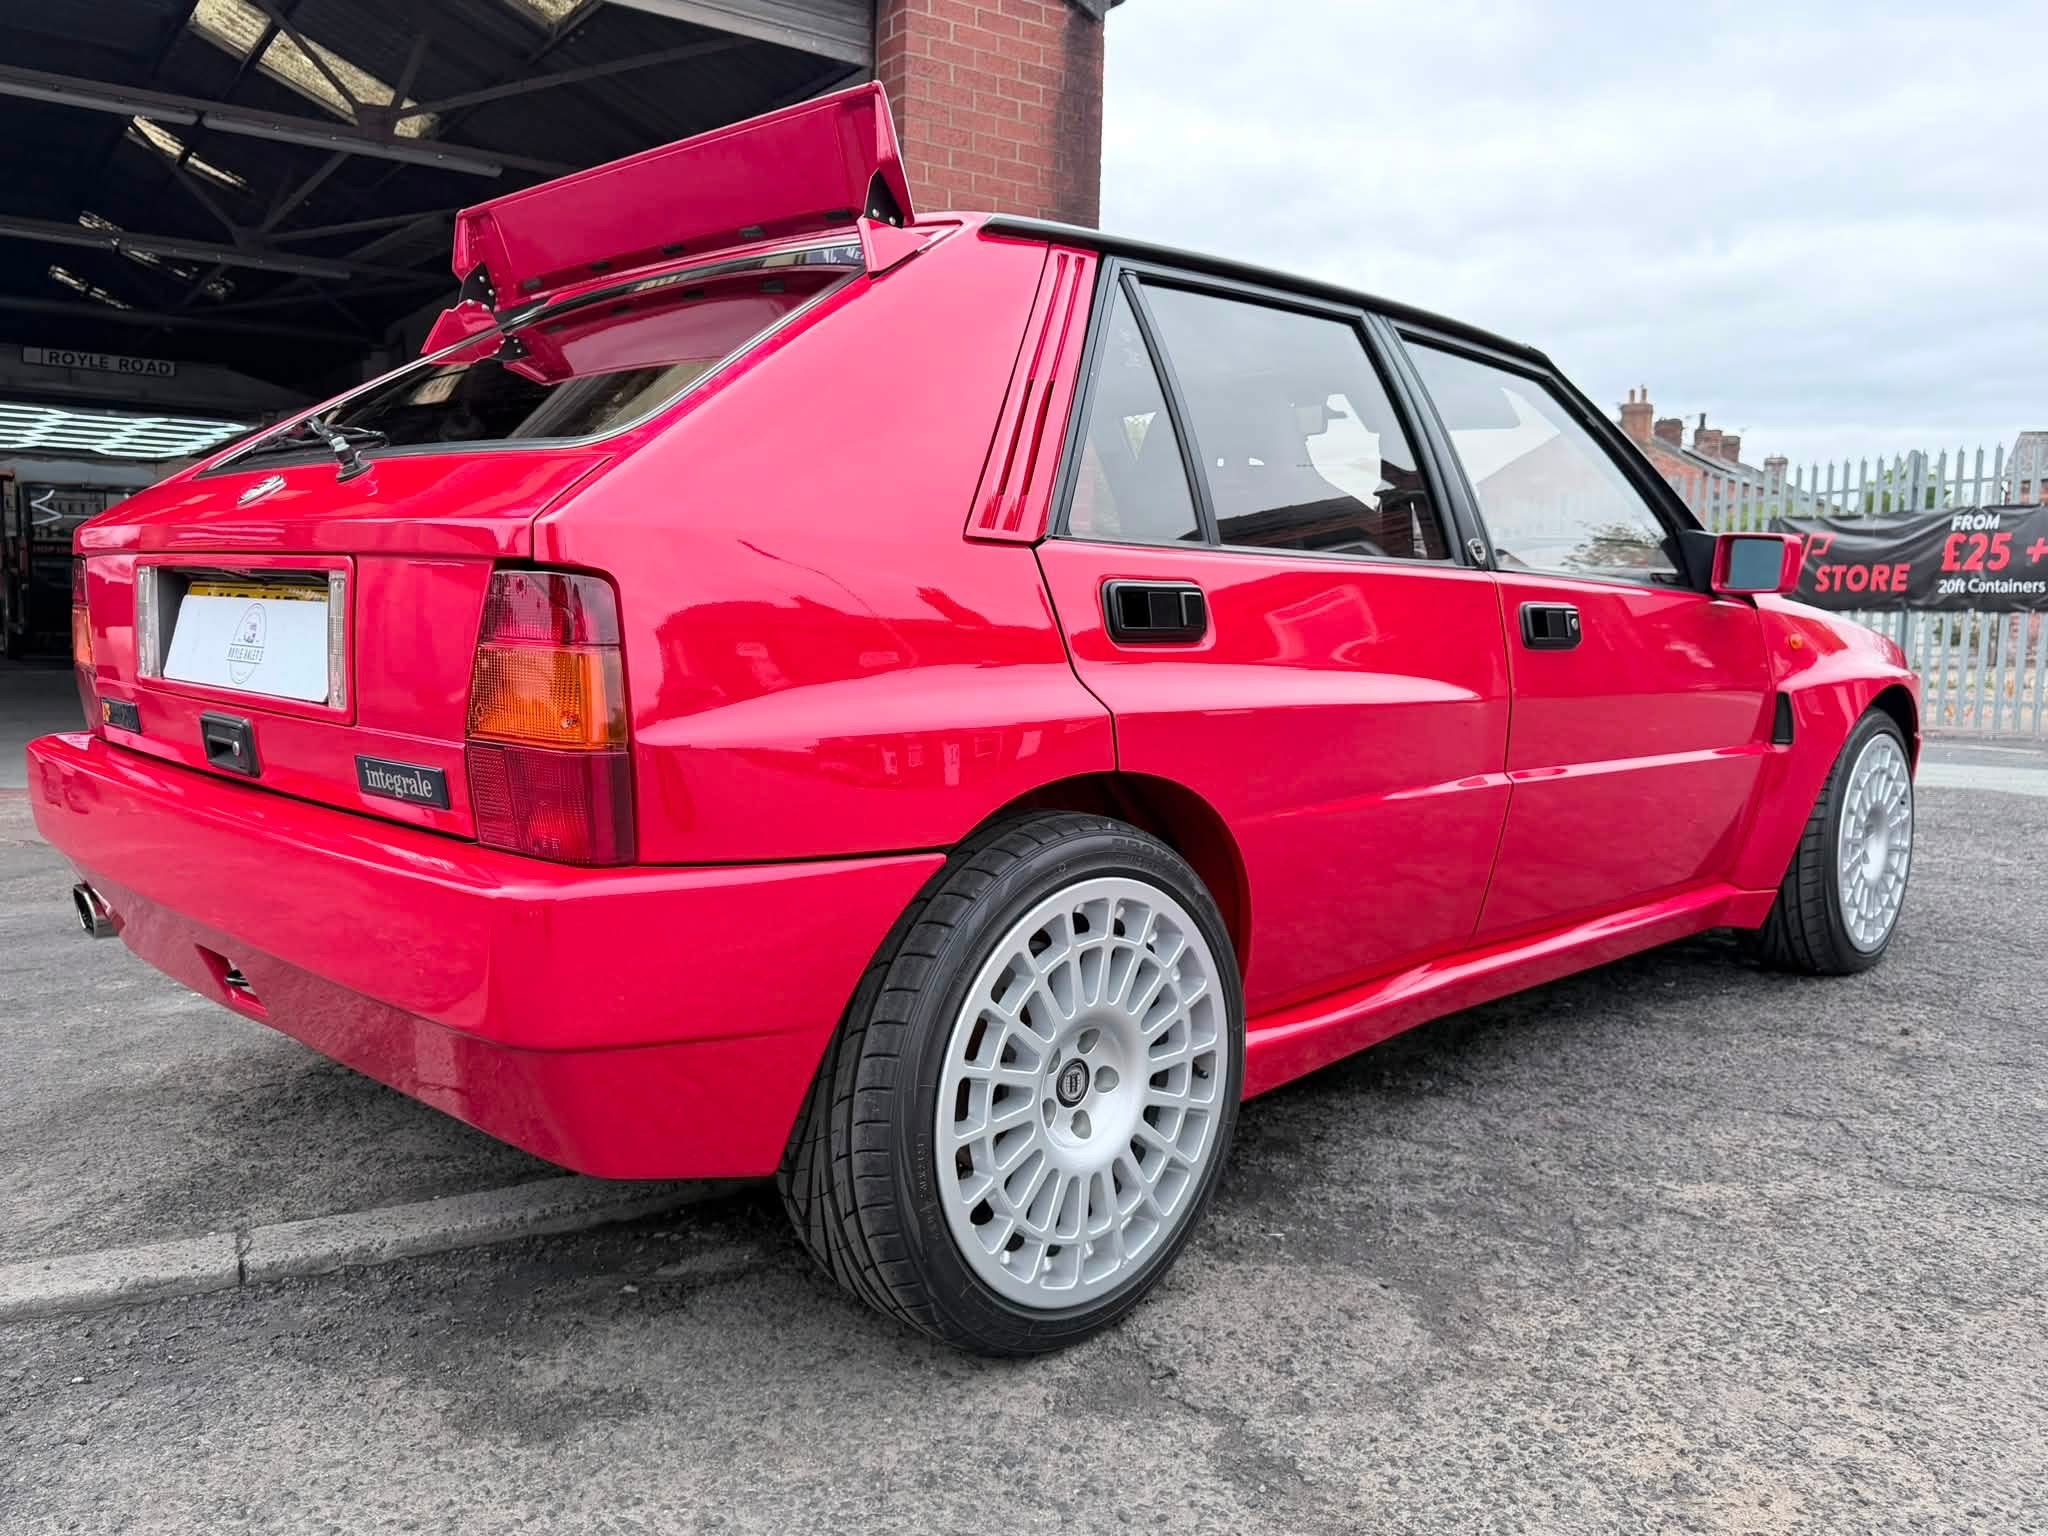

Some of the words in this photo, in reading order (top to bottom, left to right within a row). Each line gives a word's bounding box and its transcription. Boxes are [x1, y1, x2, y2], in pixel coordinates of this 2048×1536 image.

[48, 351, 110, 369] ROYLE
[119, 358, 171, 375] ROAD
[1951, 513, 2000, 532] FROM
[1941, 532, 2014, 572] £25
[1814, 563, 1911, 592] STORE
[1937, 577, 1966, 595] 20ft
[1968, 578, 2046, 594] Containers
[364, 762, 433, 798] integrale
